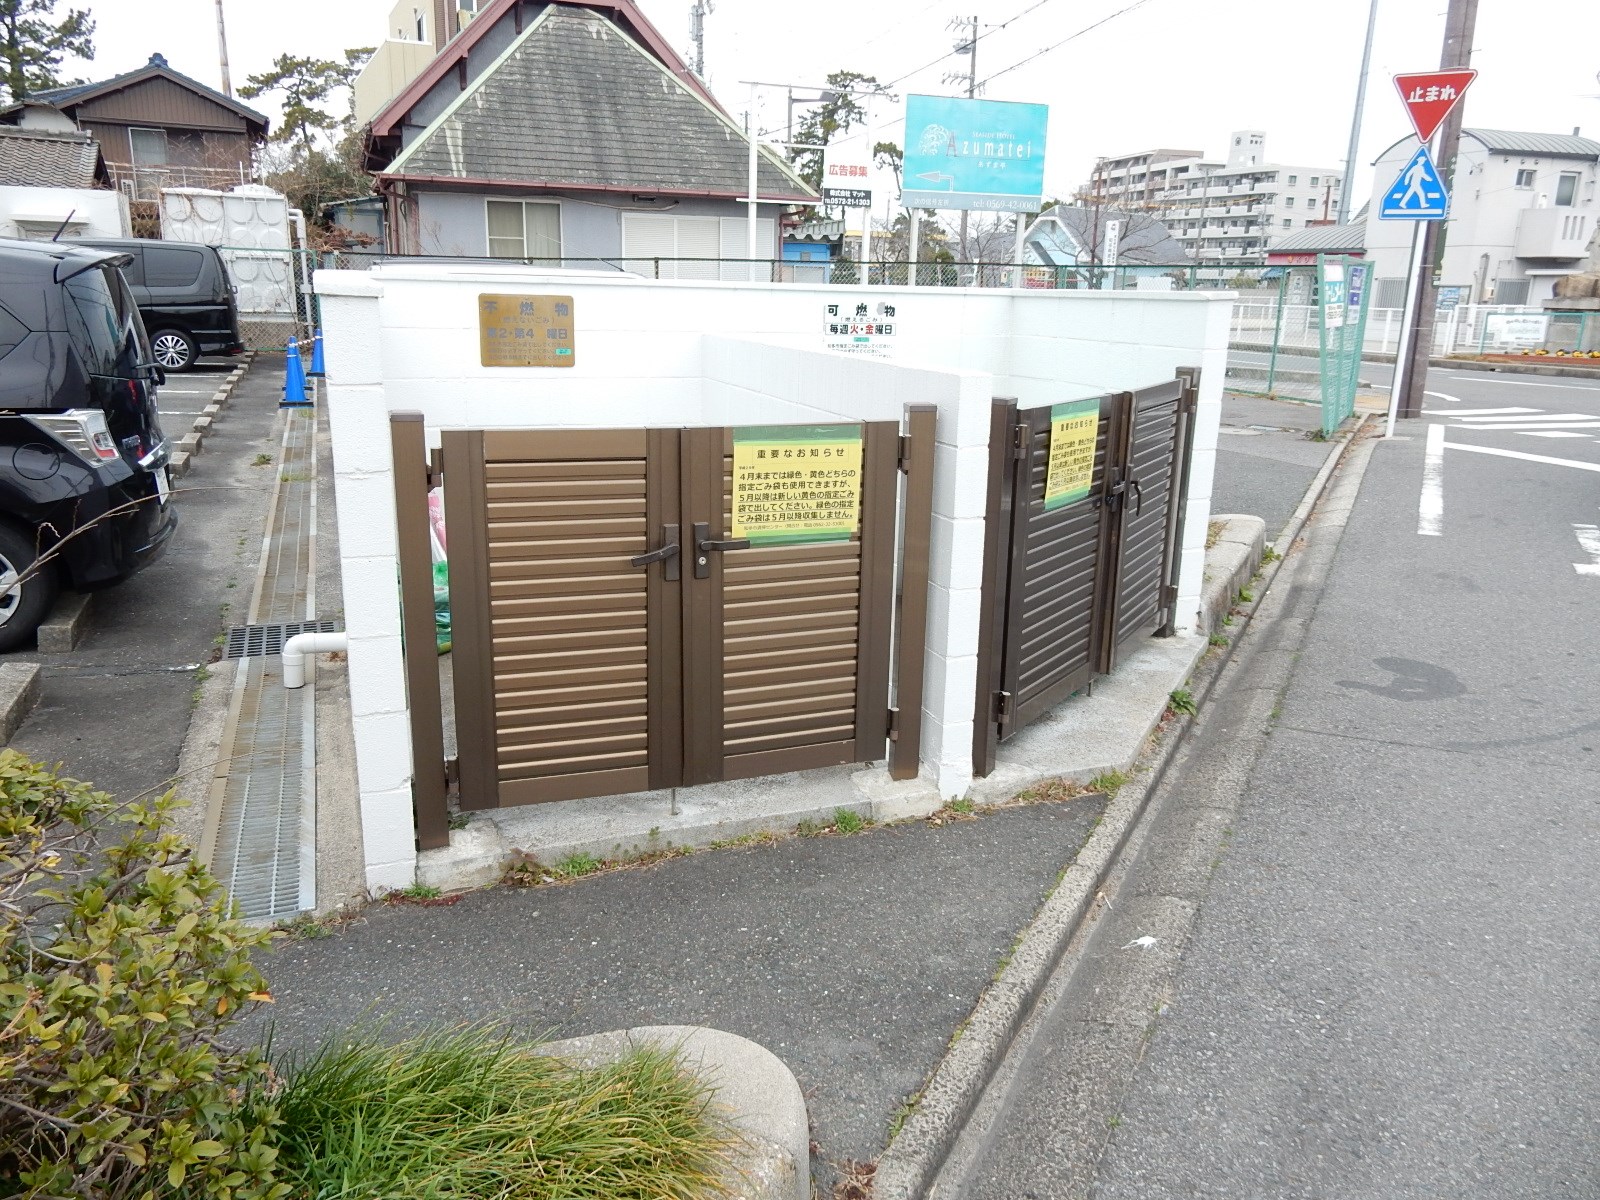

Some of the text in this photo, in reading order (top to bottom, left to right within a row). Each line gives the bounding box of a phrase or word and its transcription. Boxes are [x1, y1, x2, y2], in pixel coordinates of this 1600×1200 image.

[1407, 85, 1456, 102] 止まれ
[946, 131, 1031, 158] Azumatei
[829, 164, 868, 177] 広告募集
[829, 324, 893, 335] 毎週火・金曜日
[757, 448, 845, 459] 重要なお知らせ
[740, 469, 856, 480] 4月末までは緑色・黄色どちらの
[738, 480, 851, 492] 指定ごみ袋も使用できますが、
[739, 490, 854, 502] 5月以降は新しい黄色の指定ごみ
[738, 500, 854, 512] 袋で出してください。緑色の指定
[737, 510, 853, 523] ごみ袋は5月以降収集しません。
